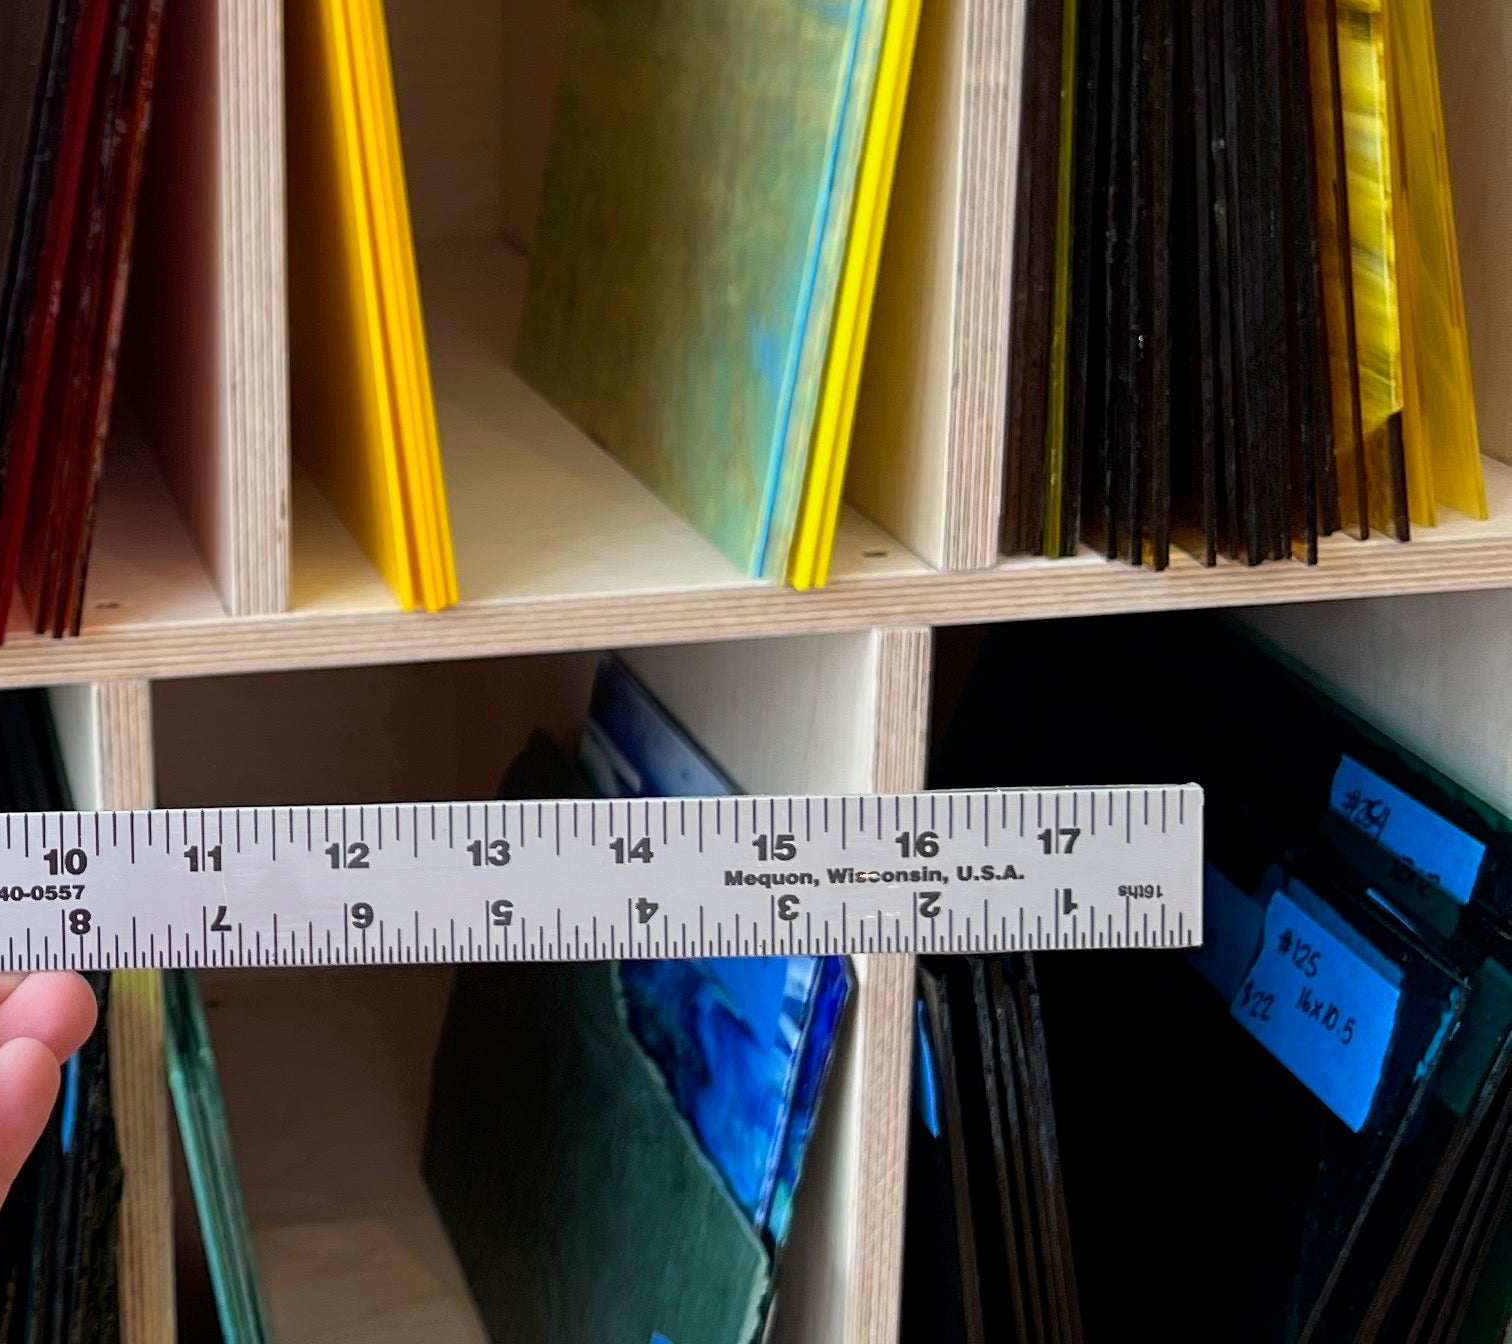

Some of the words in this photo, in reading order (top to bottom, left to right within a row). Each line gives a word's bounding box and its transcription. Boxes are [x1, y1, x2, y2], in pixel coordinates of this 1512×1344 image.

[43, 848, 88, 876] 10
[184, 845, 222, 872] 11
[325, 842, 370, 869] 12
[466, 839, 511, 866] 13
[609, 837, 654, 864] 14
[752, 834, 797, 861] 15
[895, 831, 939, 858] 16
[1038, 828, 1081, 854] 17
[724, 869, 820, 888] Mequon,
[826, 866, 949, 885] Wisconsin,
[956, 864, 1025, 881] U.S.A.
[919, 891, 942, 918] 2
[1063, 888, 1078, 915] 1
[1118, 884, 1163, 898] 16ths
[210, 906, 232, 932] 7
[491, 900, 514, 926] 5
[635, 897, 659, 924] 4
[777, 894, 800, 921] 3
[68, 908, 92, 935] 8
